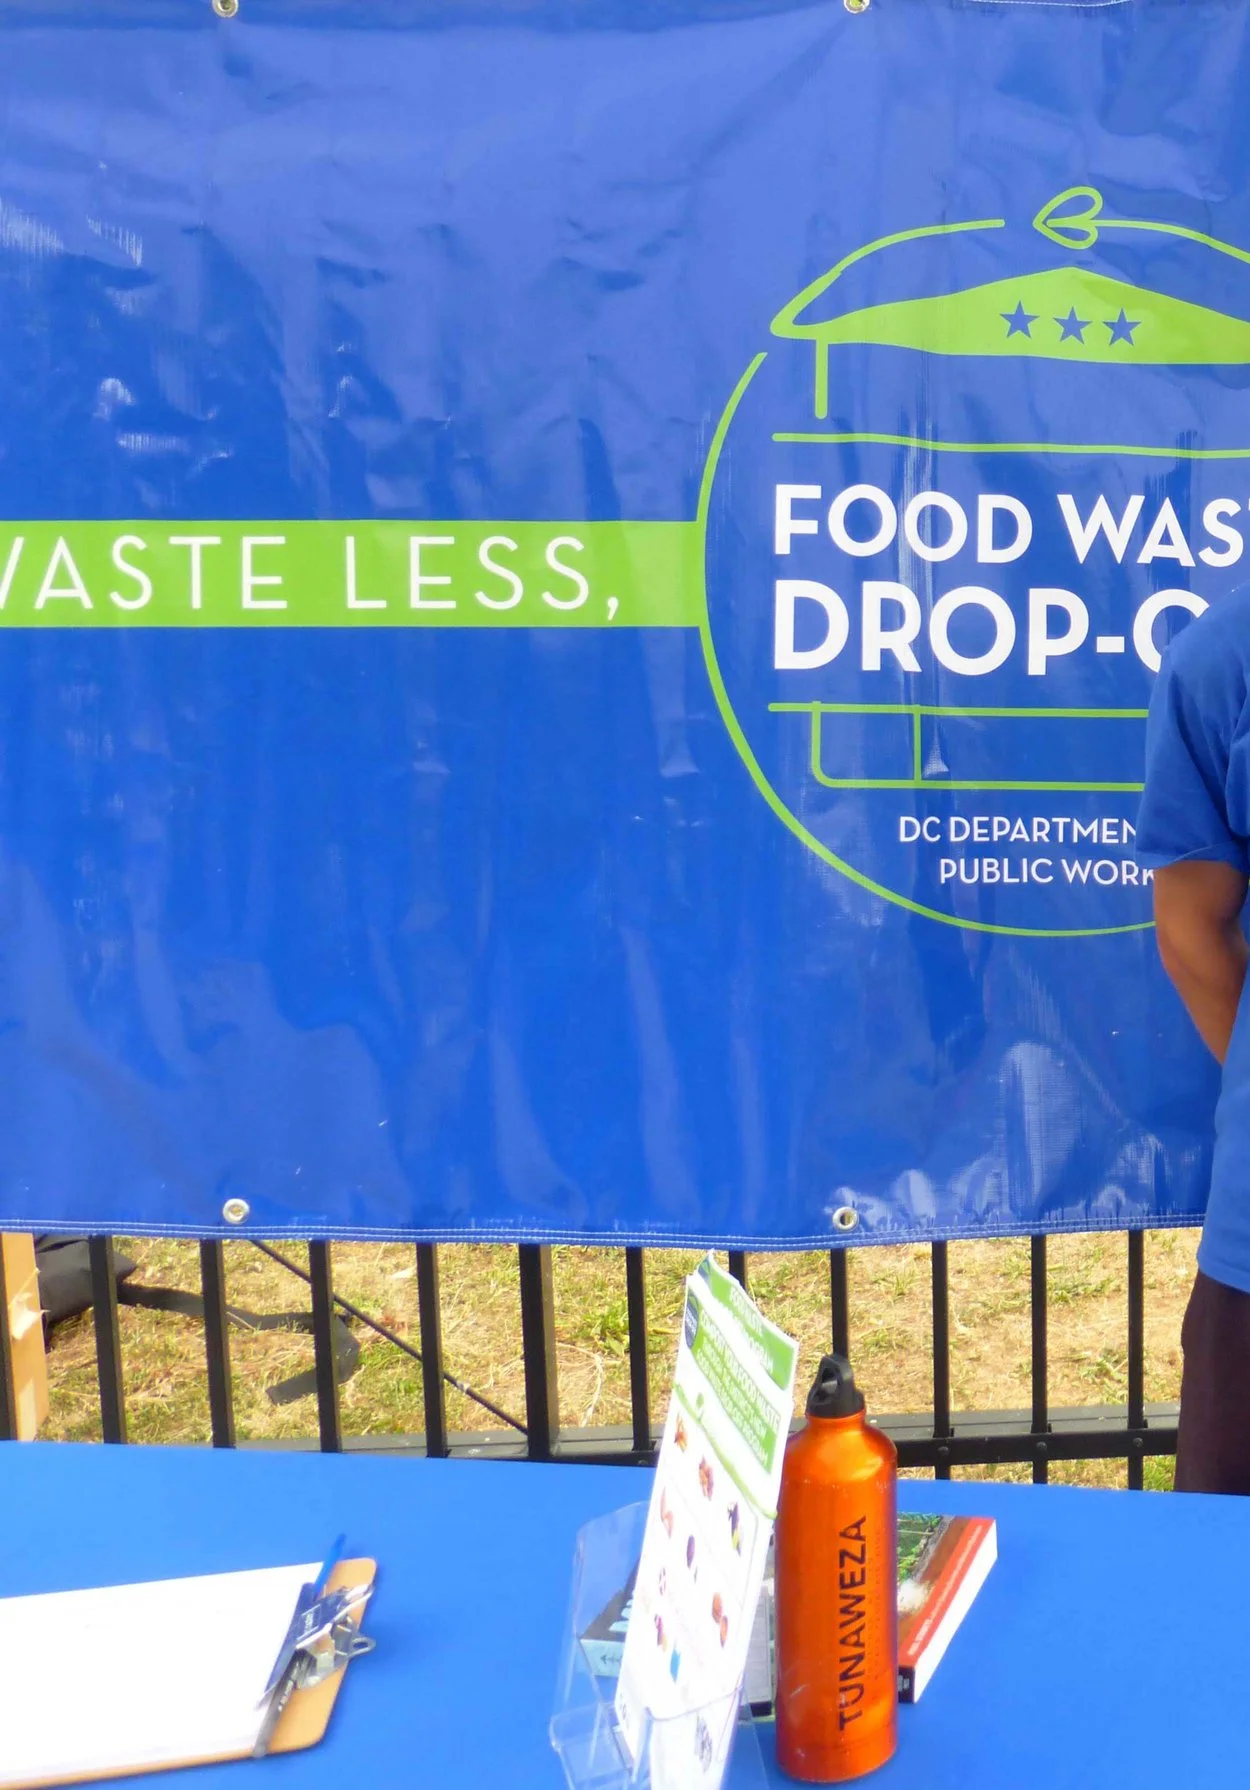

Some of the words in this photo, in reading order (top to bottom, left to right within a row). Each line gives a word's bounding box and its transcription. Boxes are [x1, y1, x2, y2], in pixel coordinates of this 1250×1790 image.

[774, 484, 1033, 564] FOOD
[345, 535, 619, 620] LESS,
[899, 816, 941, 843] DC
[940, 858, 1053, 885] PUBLIC
[838, 1514, 868, 1732] TUNAWEZA
